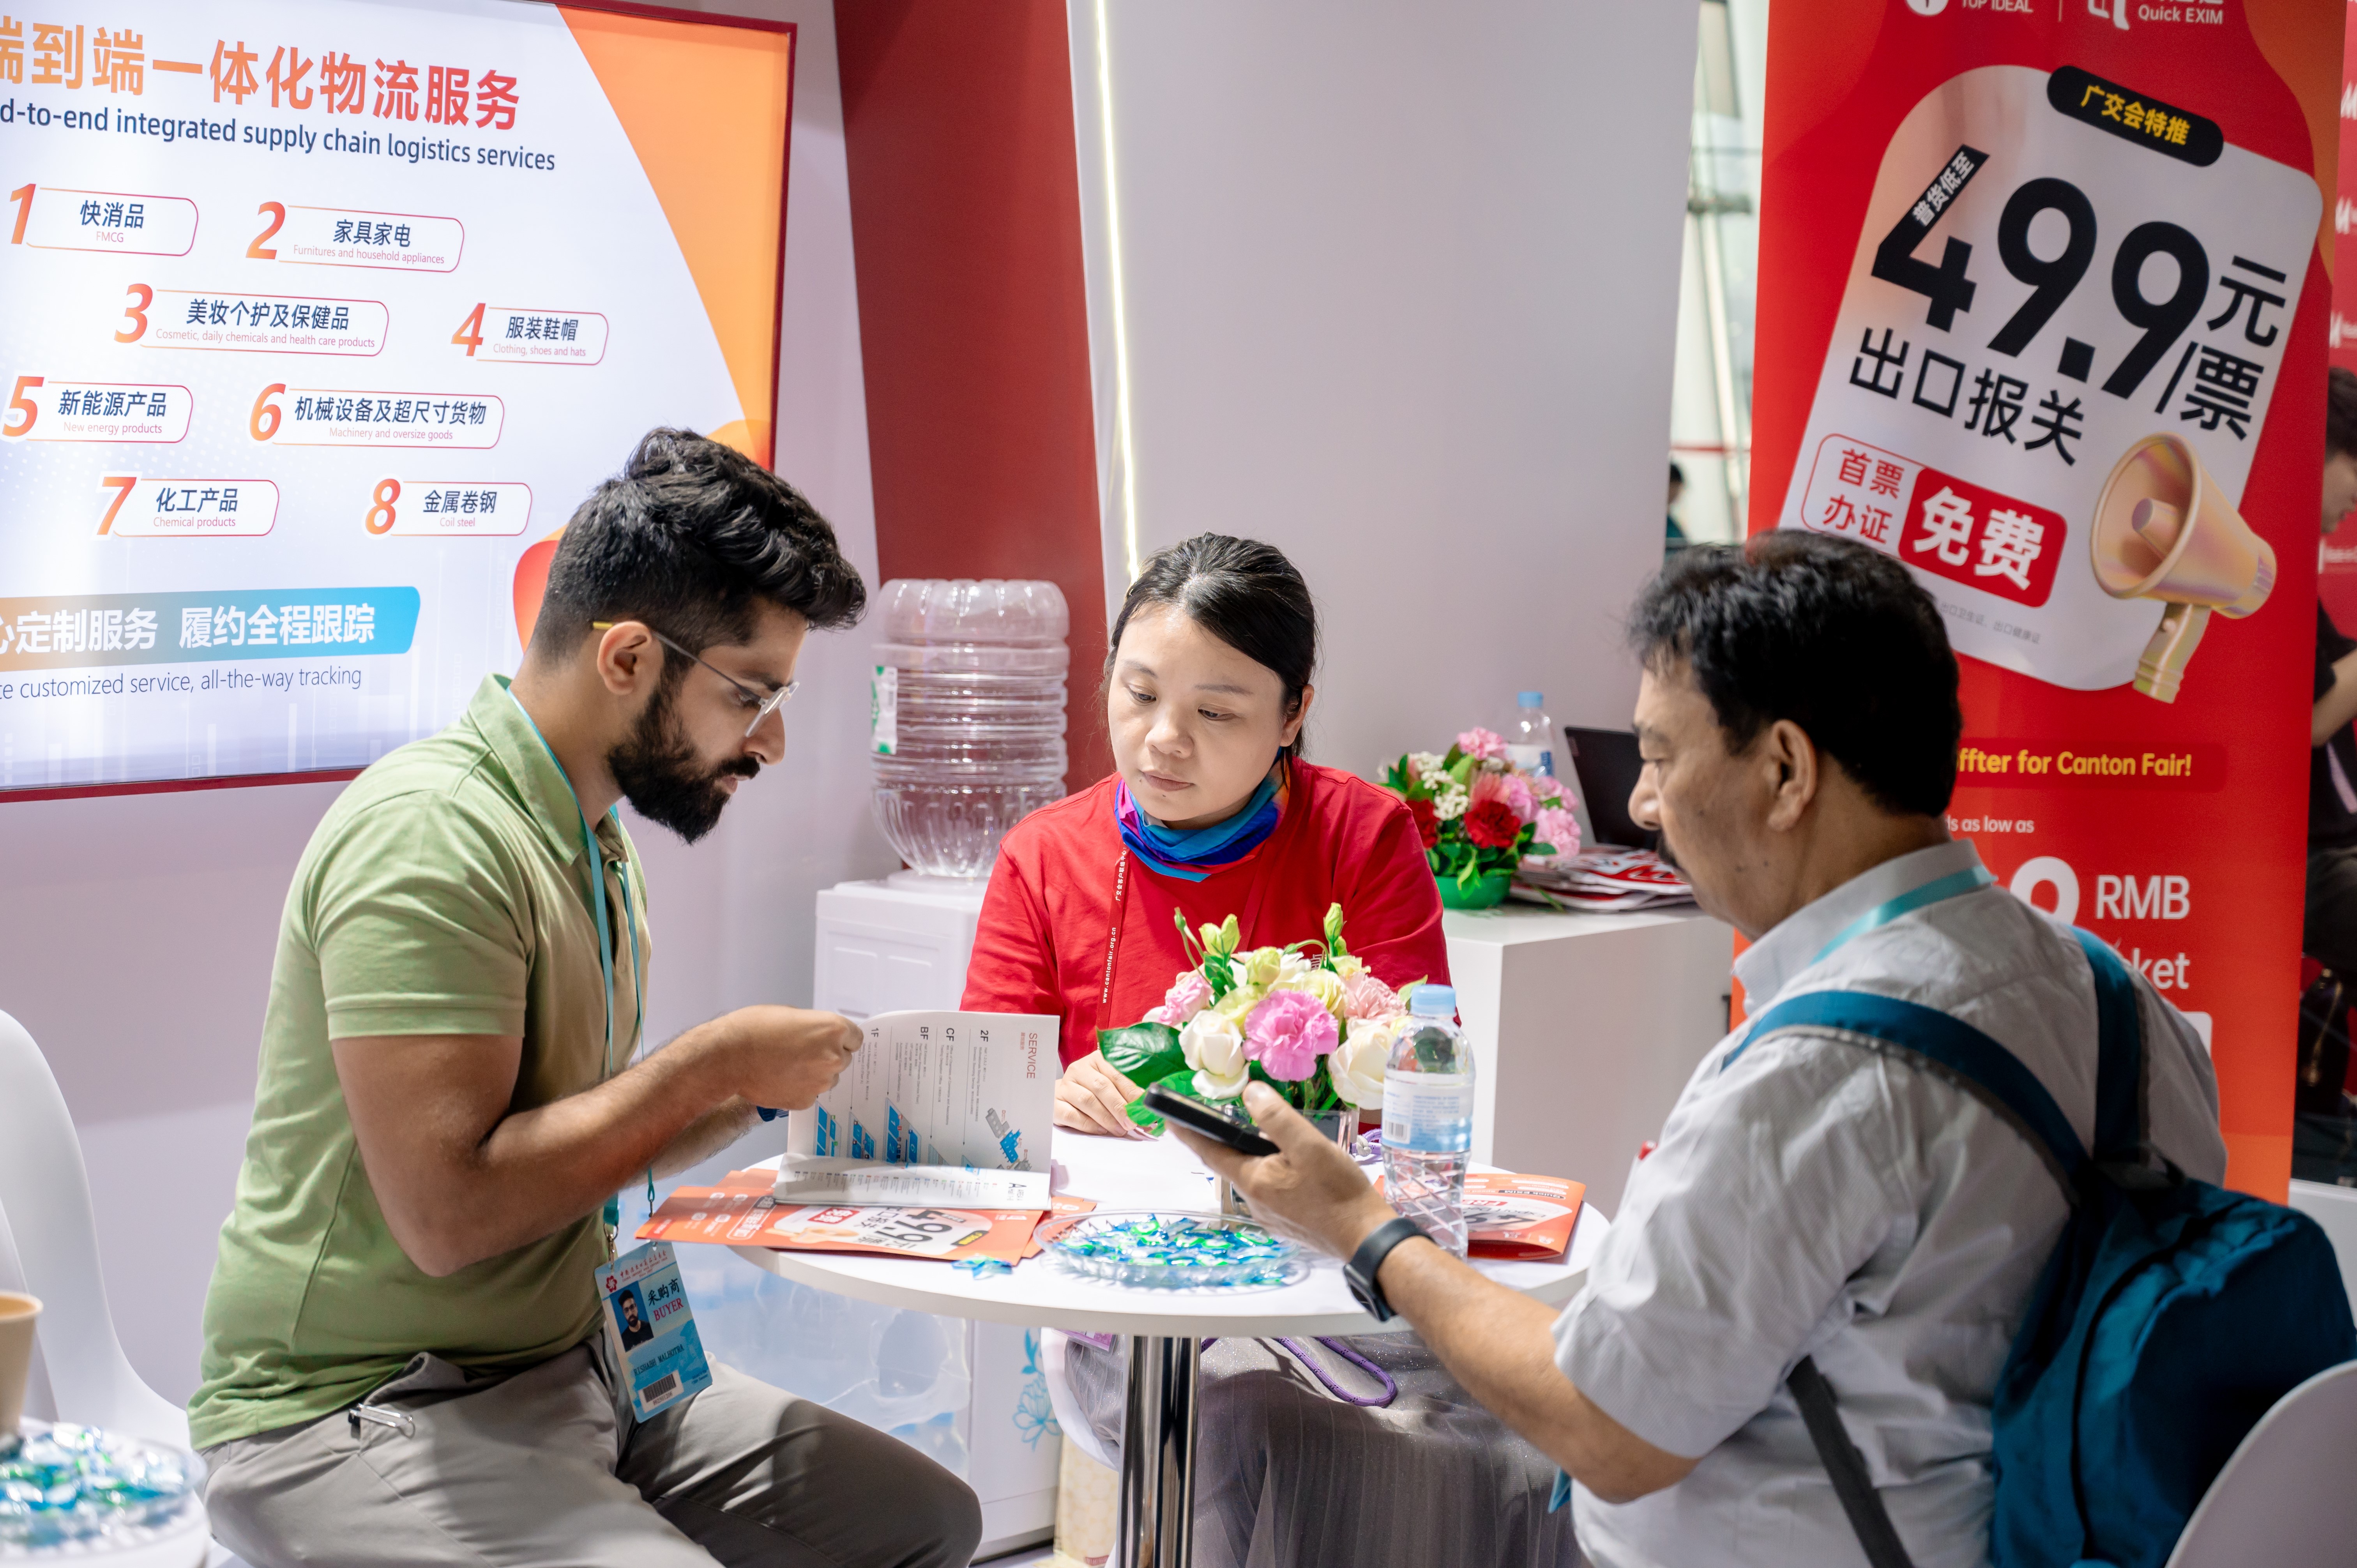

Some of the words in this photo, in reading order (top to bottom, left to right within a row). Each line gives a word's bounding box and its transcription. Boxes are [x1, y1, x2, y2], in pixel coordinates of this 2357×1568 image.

[1991, 0, 2034, 13] IDEAL
[2138, 4, 2180, 21] Quick
[2186, 7, 2223, 24] EXIM
[2080, 85, 2191, 145] 广交会特推
[117, 109, 236, 142] integrated
[243, 122, 316, 154] supply
[323, 129, 380, 154] chain
[389, 132, 470, 163] logistics
[477, 147, 555, 171] services
[1912, 151, 1975, 227] 普货低至
[9, 184, 36, 244] 1
[80, 200, 145, 229] 快消品
[96, 231, 124, 243] FMCG
[246, 201, 286, 260] 2
[333, 219, 411, 248] 家具家电
[293, 245, 336, 258] Furnitures
[339, 247, 354, 258] and
[356, 248, 399, 262] household
[402, 251, 444, 264] appliances
[1871, 145, 2210, 400] 49.9
[114, 283, 153, 343] 3
[186, 299, 349, 330] 美妆个护及保健品
[2207, 255, 2287, 349] 元
[156, 329, 199, 341] Cosmetic,
[202, 330, 223, 343] daily
[226, 331, 268, 343] chemicals
[271, 332, 287, 343] and
[290, 333, 316, 345] health
[318, 336, 336, 346] care
[338, 336, 375, 349] products
[451, 302, 486, 357] 4
[506, 316, 578, 342] 服装鞋帽
[493, 343, 528, 357] Clothing,
[530, 345, 551, 356] shoes
[554, 346, 568, 356] and
[570, 346, 586, 357] hats
[2, 376, 44, 436] 5
[58, 390, 166, 417] 新能源产品
[294, 396, 486, 426] 机械设备及超尺寸货物
[1849, 327, 2084, 466] 出口报关
[250, 383, 286, 441] 6
[64, 422, 85, 432] New
[87, 424, 119, 435] energy
[122, 422, 162, 436] products
[329, 427, 372, 440] Machinery
[375, 428, 390, 439] and
[393, 428, 425, 440] oversize
[428, 429, 453, 441] goods
[1836, 448, 1905, 500] 首票
[96, 477, 137, 535] 7
[156, 487, 238, 513] 化工产品
[365, 479, 401, 535] 8
[423, 490, 497, 514] 金属卷钢
[154, 517, 194, 527] Chemical
[197, 517, 236, 529] products
[440, 517, 454, 527] Coil
[457, 518, 475, 527] steel
[1823, 496, 1894, 545] 办证
[1914, 486, 2045, 591] 免费
[179, 603, 375, 648] 履约全程跟踪
[20, 673, 123, 699] customized
[130, 672, 194, 693] service,
[201, 669, 293, 691] all-the-way
[299, 665, 362, 689] tracking
[1958, 748, 2012, 773] ffter
[2018, 749, 2052, 774] for
[2057, 751, 2136, 775] Canton
[2141, 753, 2192, 777] Fair!
[1961, 818, 1981, 832] as
[1984, 816, 2012, 832] low
[2015, 819, 2035, 833] as
[2096, 874, 2190, 920] RMB
[1103, 927, 1117, 1003] www.cantonfair.org.cn
[871, 1028, 879, 1038] 1F
[920, 1026, 929, 1041] BF
[946, 1028, 954, 1042] CF
[980, 1029, 989, 1043] 2F
[1027, 1032, 1038, 1079] SERVICE
[648, 1278, 680, 1306] 采购商
[653, 1298, 684, 1322] BUYER
